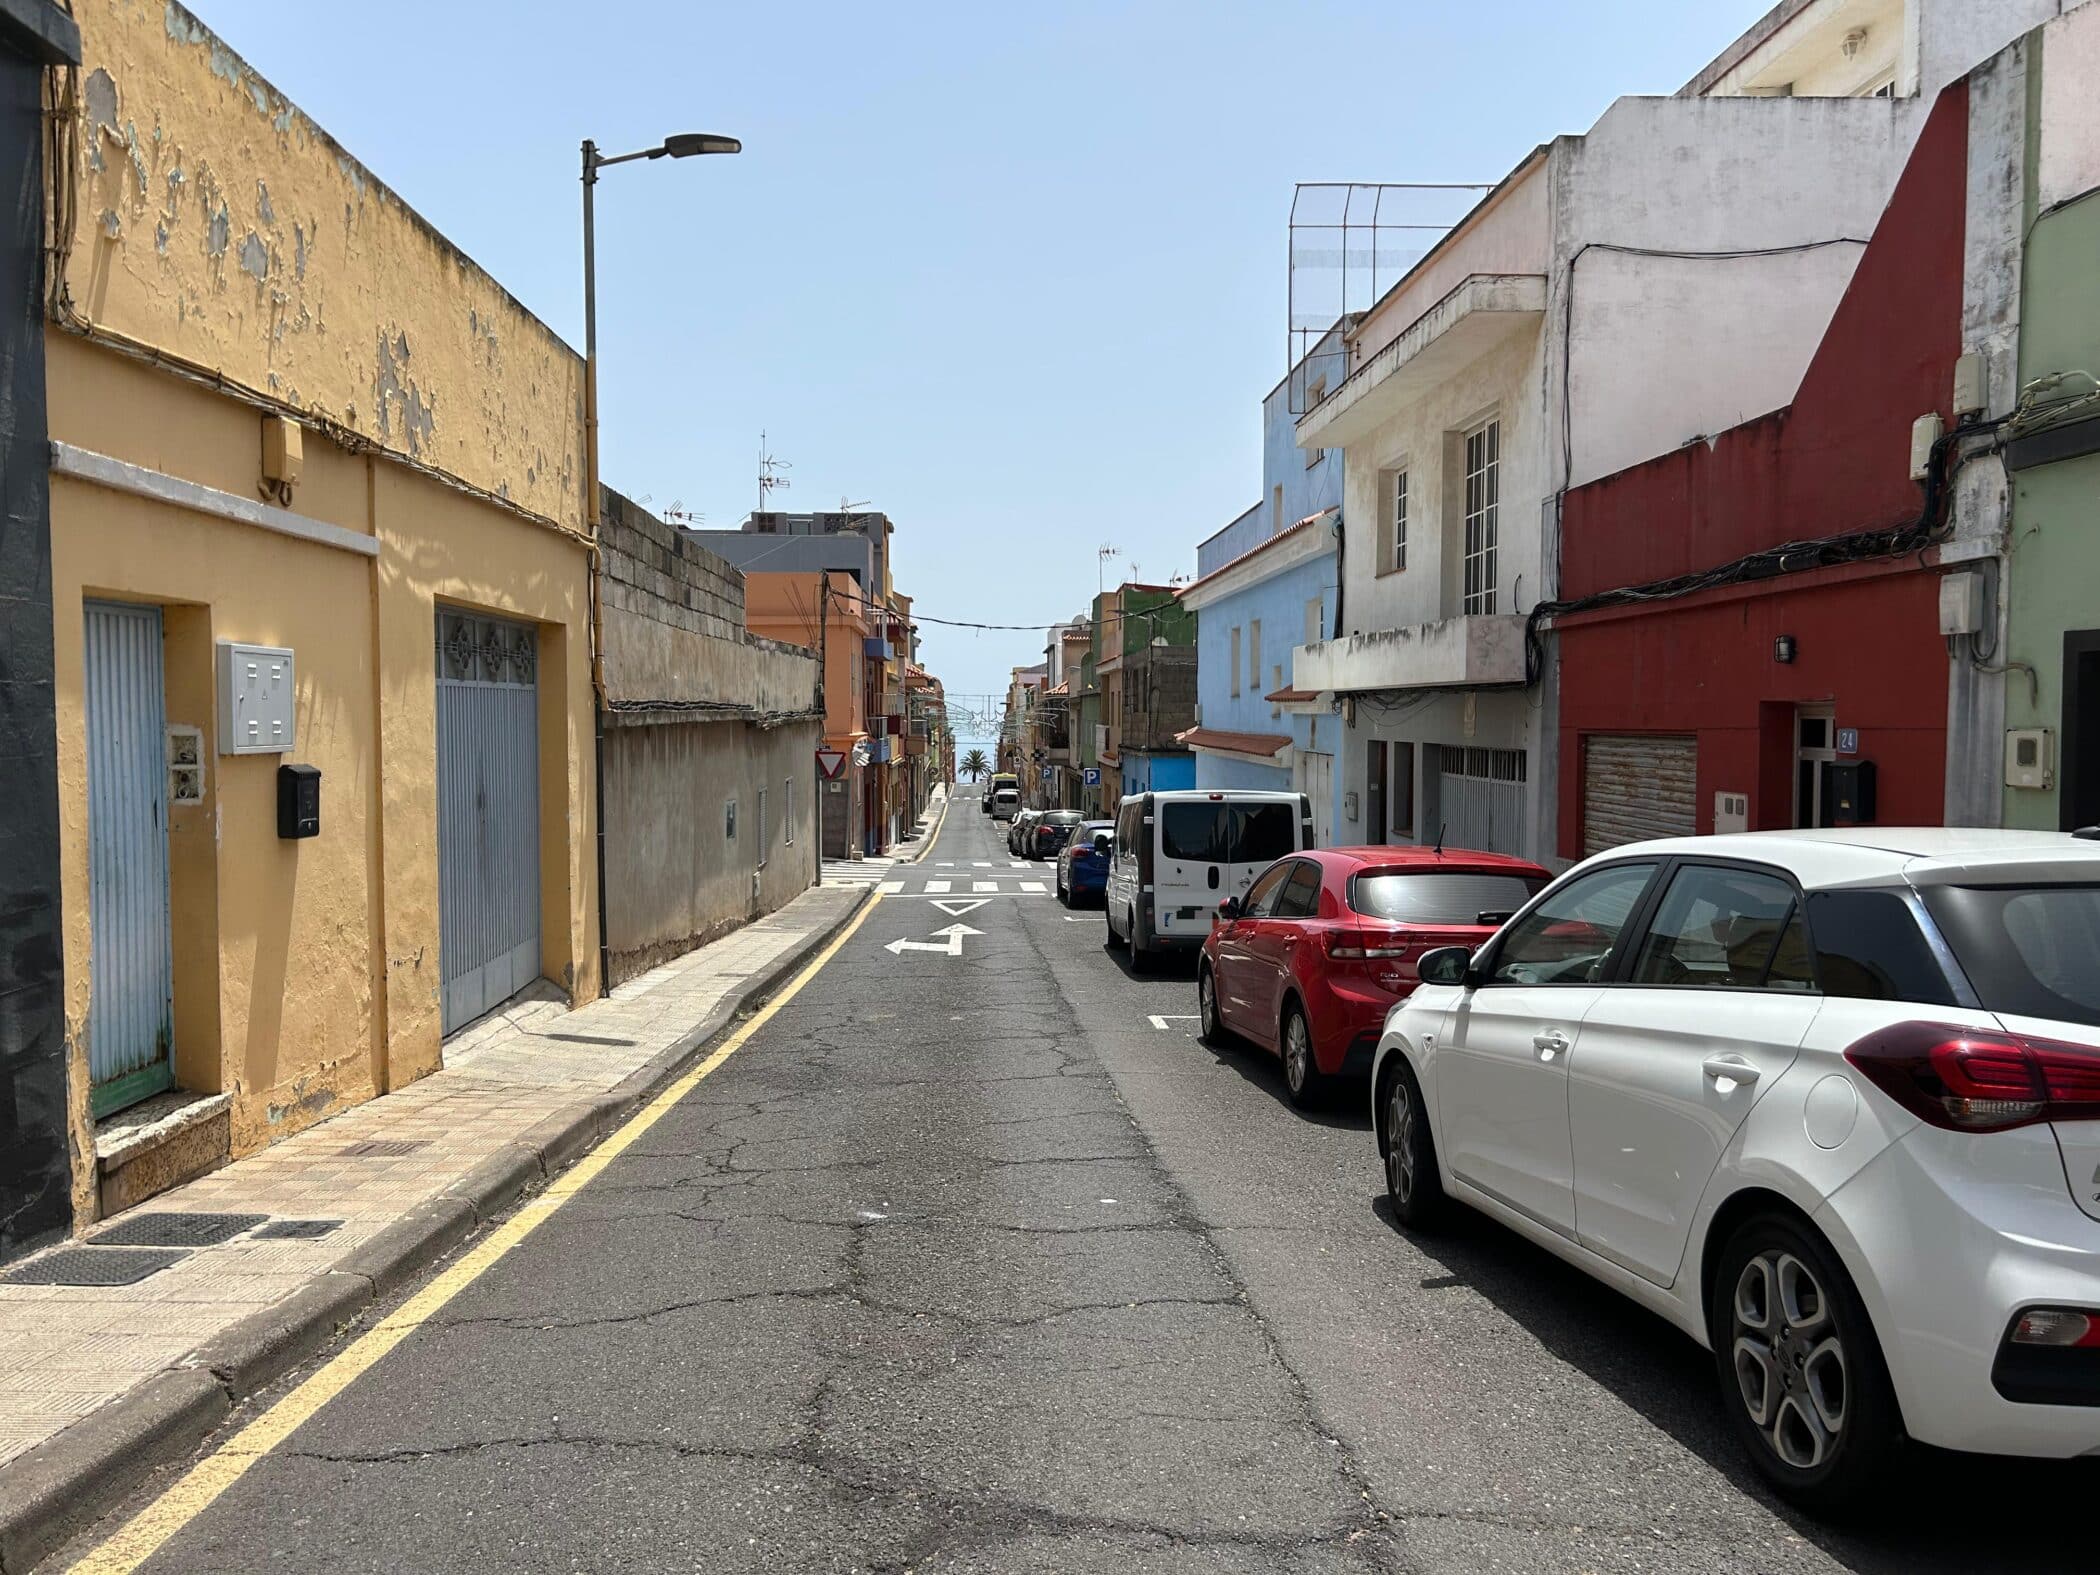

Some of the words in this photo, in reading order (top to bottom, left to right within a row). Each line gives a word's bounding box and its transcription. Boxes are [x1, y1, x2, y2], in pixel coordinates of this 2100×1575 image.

[1841, 732, 1853, 748] 24
[1043, 769, 1051, 778] P
[1087, 770, 1097, 783] P
